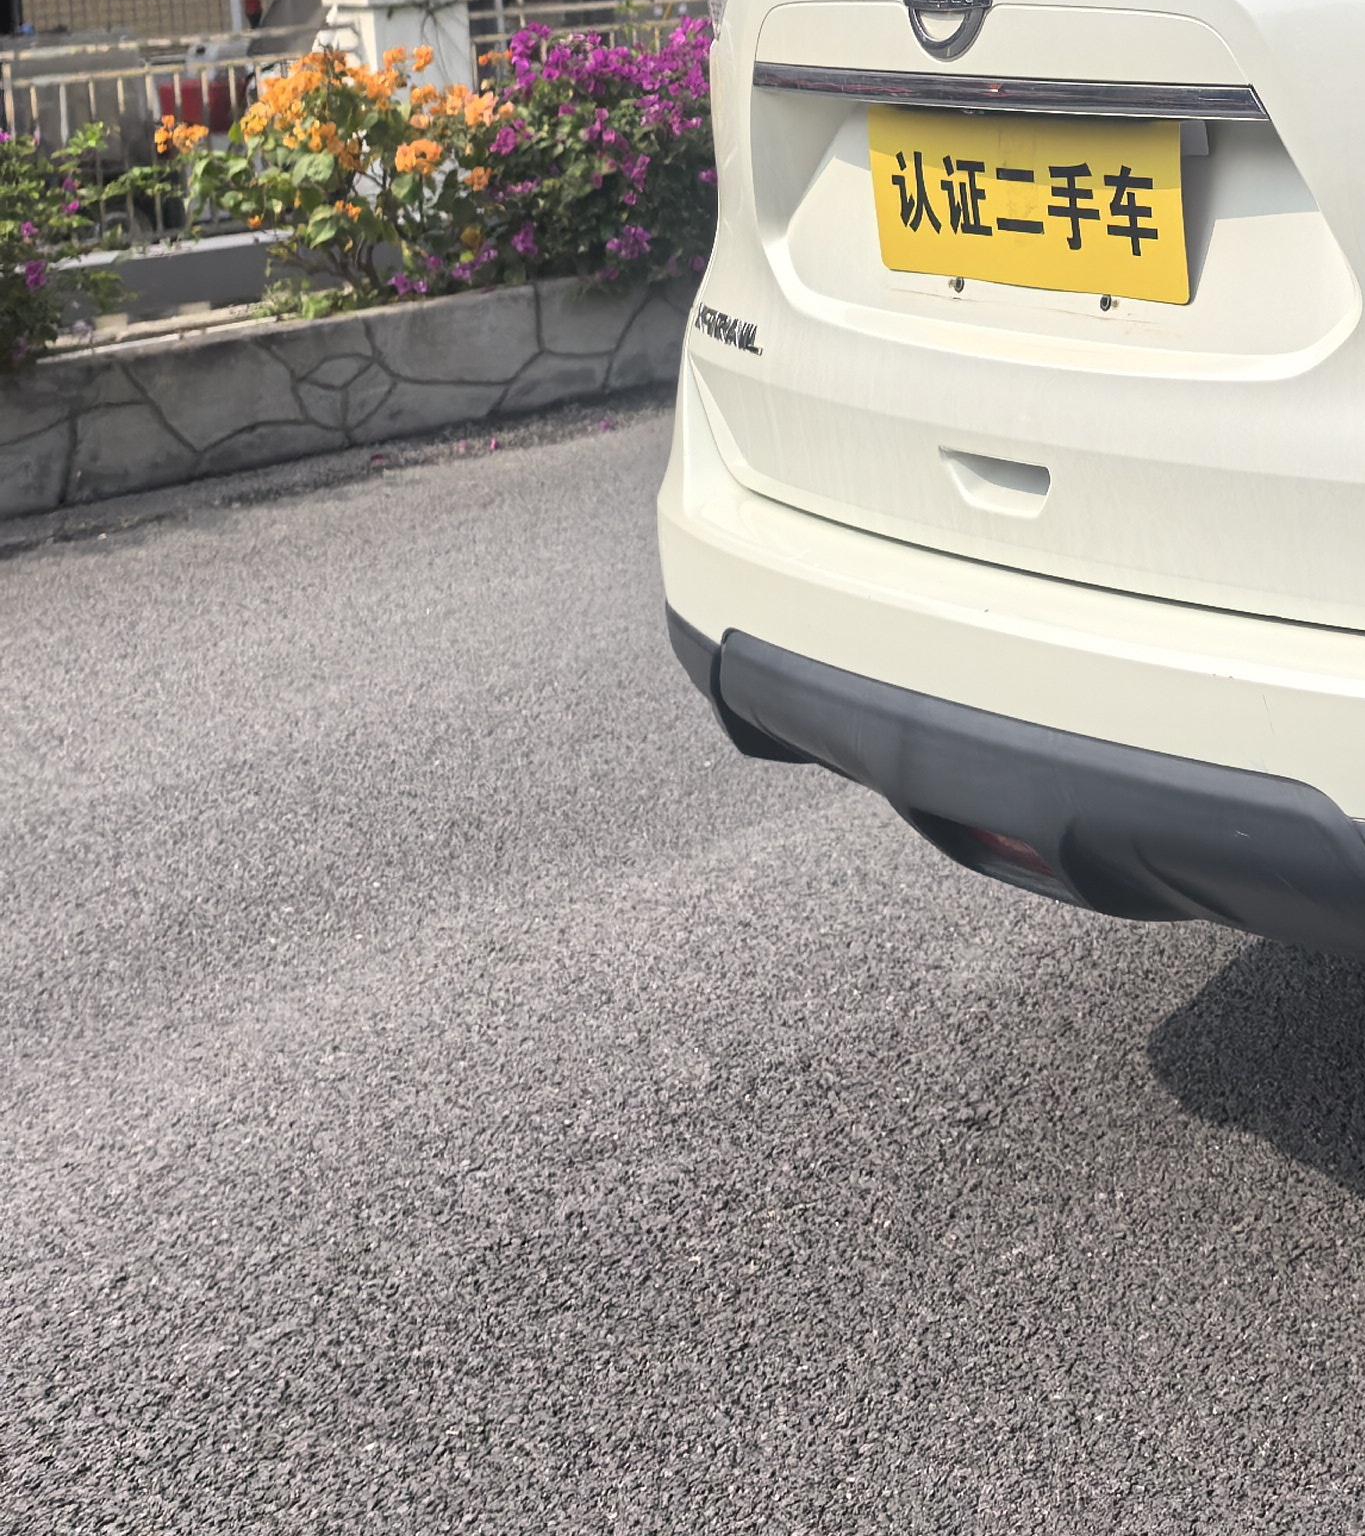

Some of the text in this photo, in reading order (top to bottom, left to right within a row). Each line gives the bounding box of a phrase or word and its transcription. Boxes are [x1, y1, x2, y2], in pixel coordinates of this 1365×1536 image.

[891, 151, 1158, 257] 认证二手车
